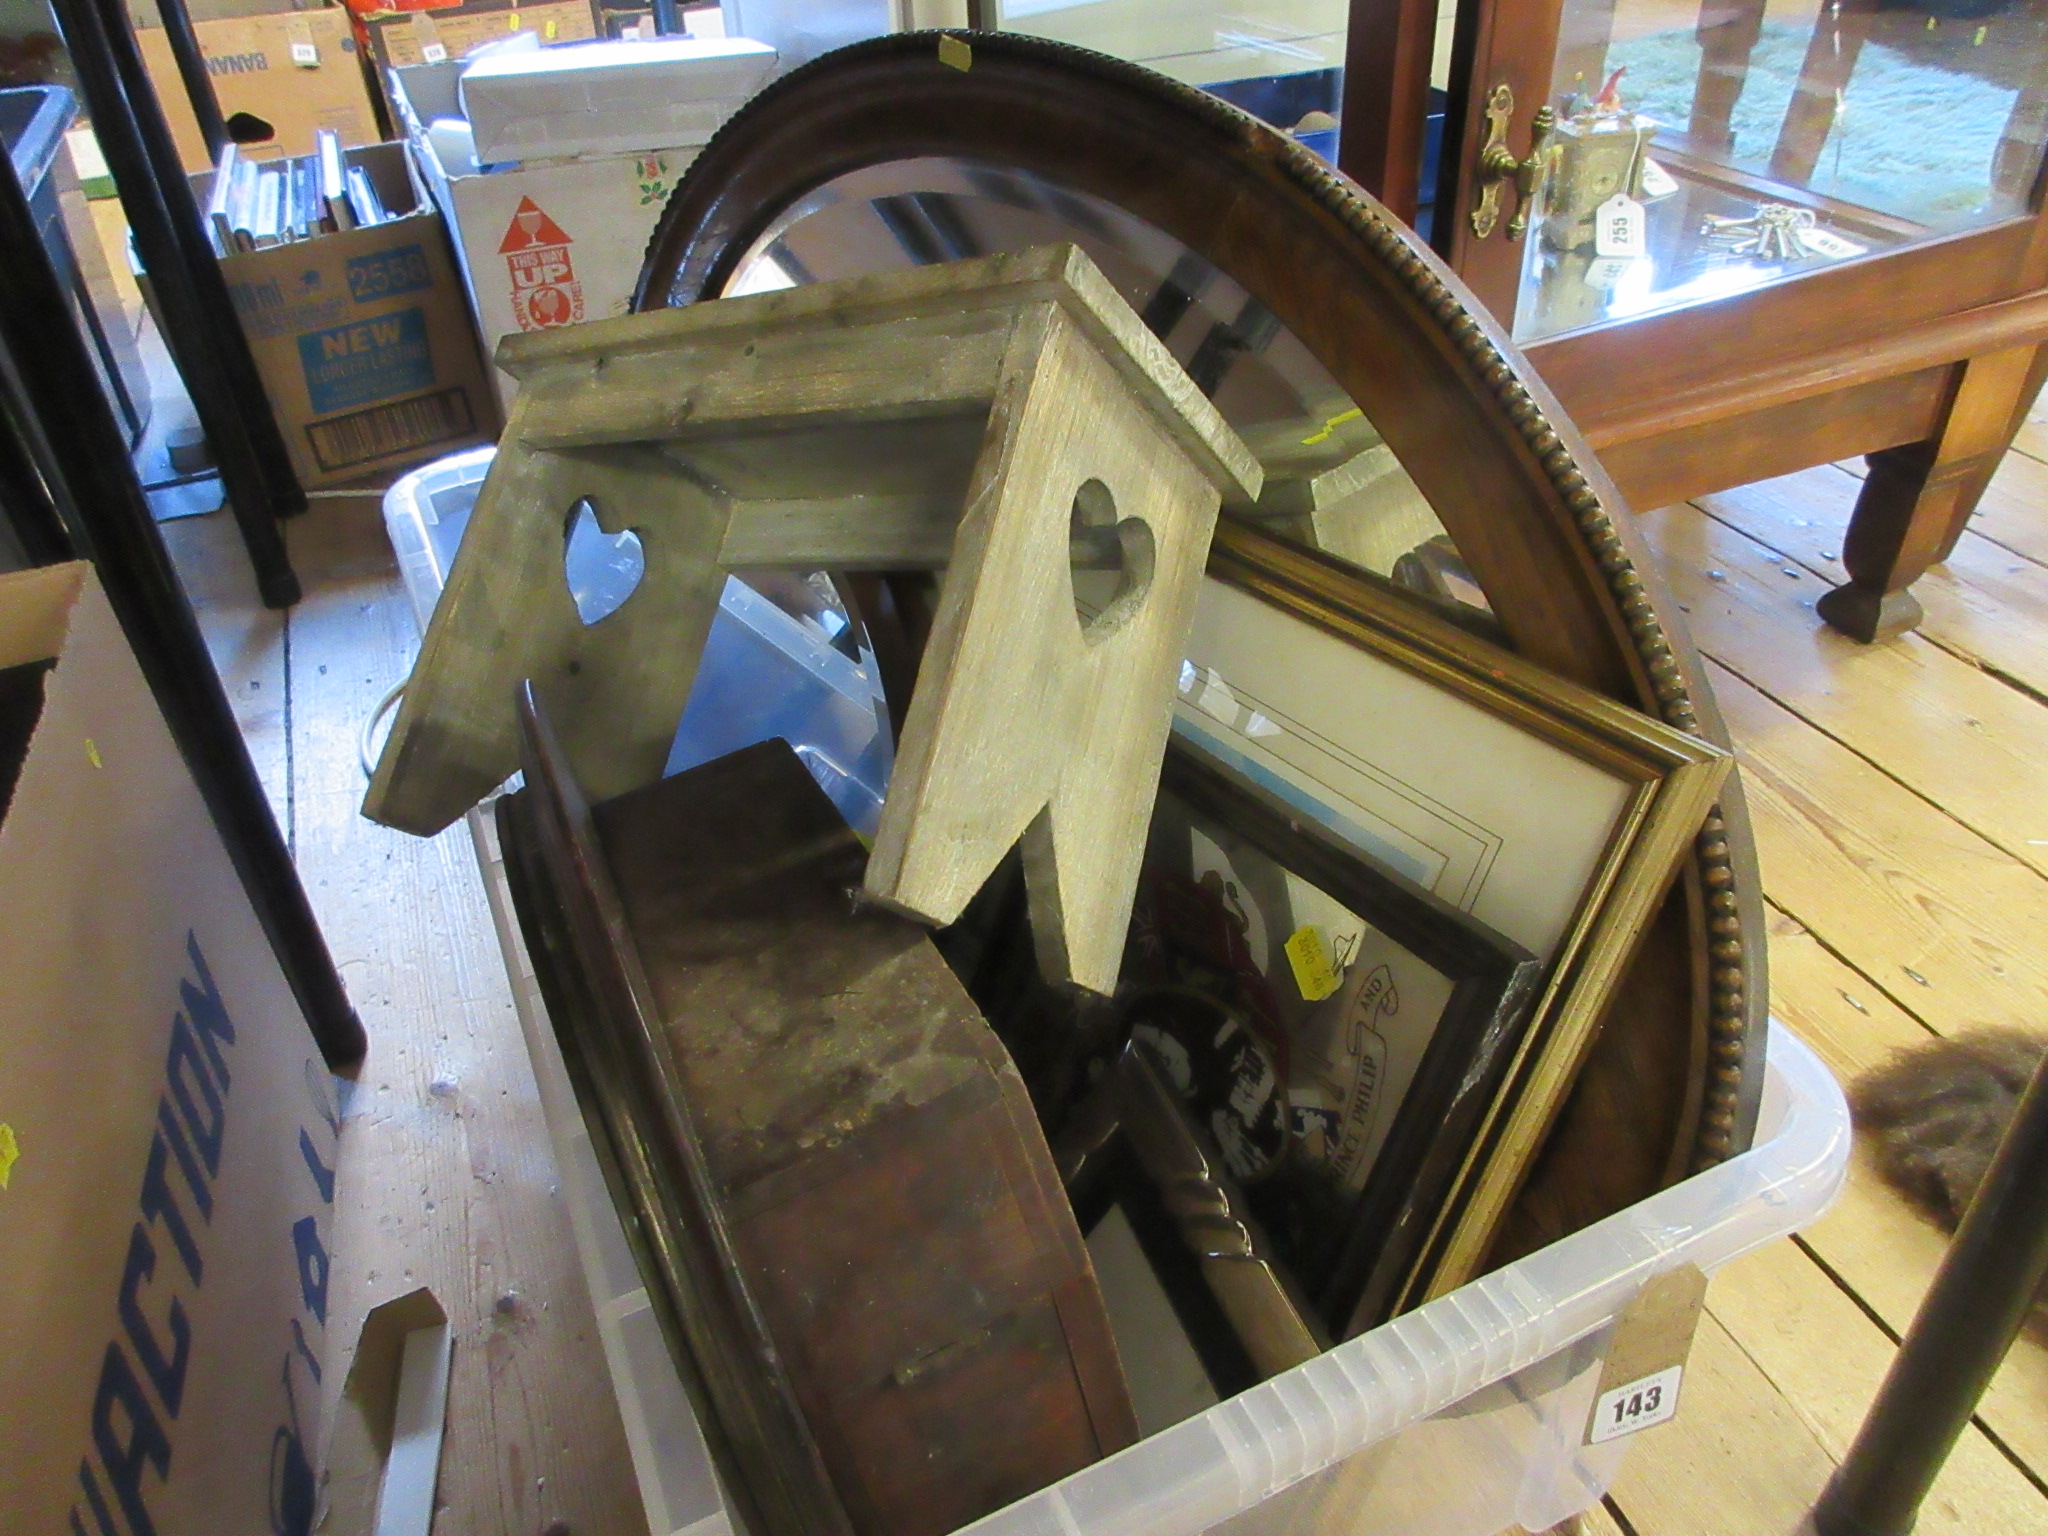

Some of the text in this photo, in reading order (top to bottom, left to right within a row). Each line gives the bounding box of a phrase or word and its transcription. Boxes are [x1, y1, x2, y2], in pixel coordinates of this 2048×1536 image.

[1612, 217, 1628, 244] 255
[511, 248, 565, 268] THIS WAY
[514, 263, 569, 288] UP
[322, 318, 401, 360] NEW
[1359, 978, 1383, 1011] AND
[1352, 1056, 1378, 1125] PHILIP
[69, 928, 236, 1536] ACTION
[1613, 1386, 1662, 1423] 143
